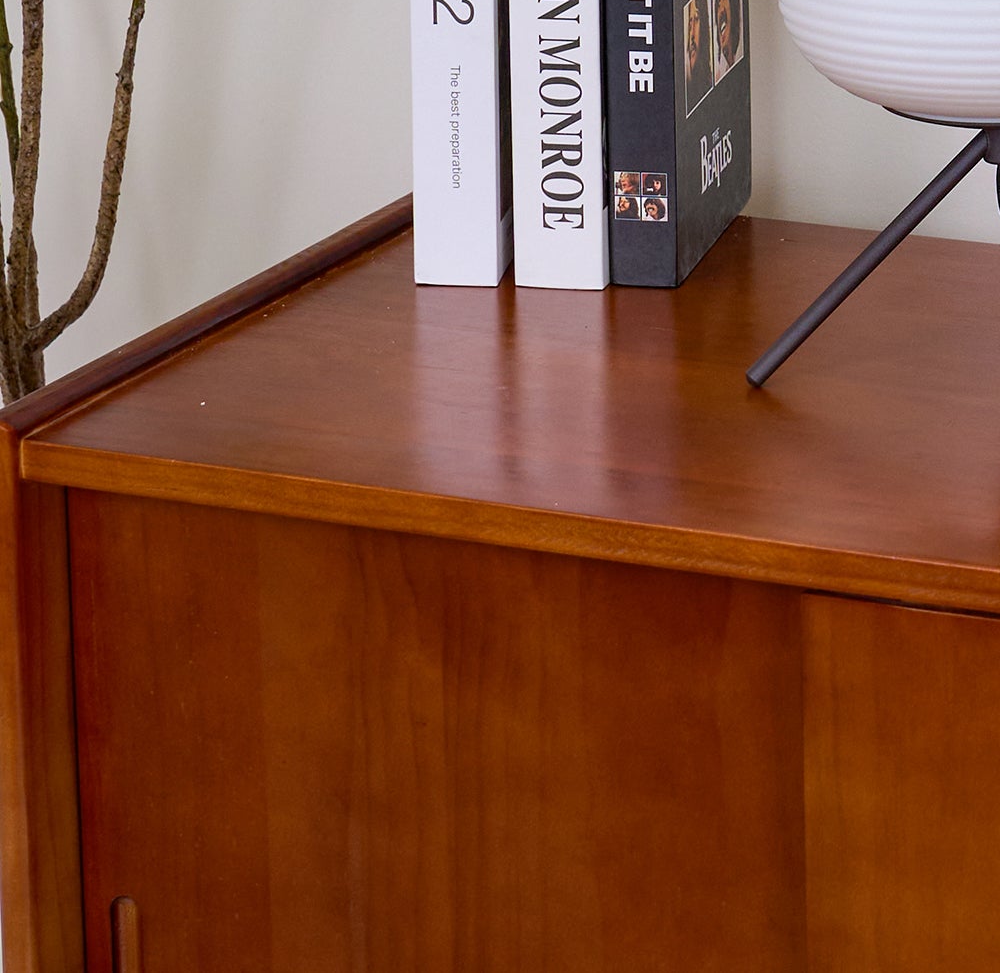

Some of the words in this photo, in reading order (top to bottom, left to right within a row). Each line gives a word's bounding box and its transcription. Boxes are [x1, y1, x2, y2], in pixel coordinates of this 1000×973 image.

[627, 13, 653, 45] IT
[450, 64, 461, 87] The
[628, 50, 654, 93] BE
[450, 91, 461, 117] best
[538, 34, 585, 230] MONROE
[449, 120, 463, 189] preparation
[700, 130, 733, 195] BEATLES
